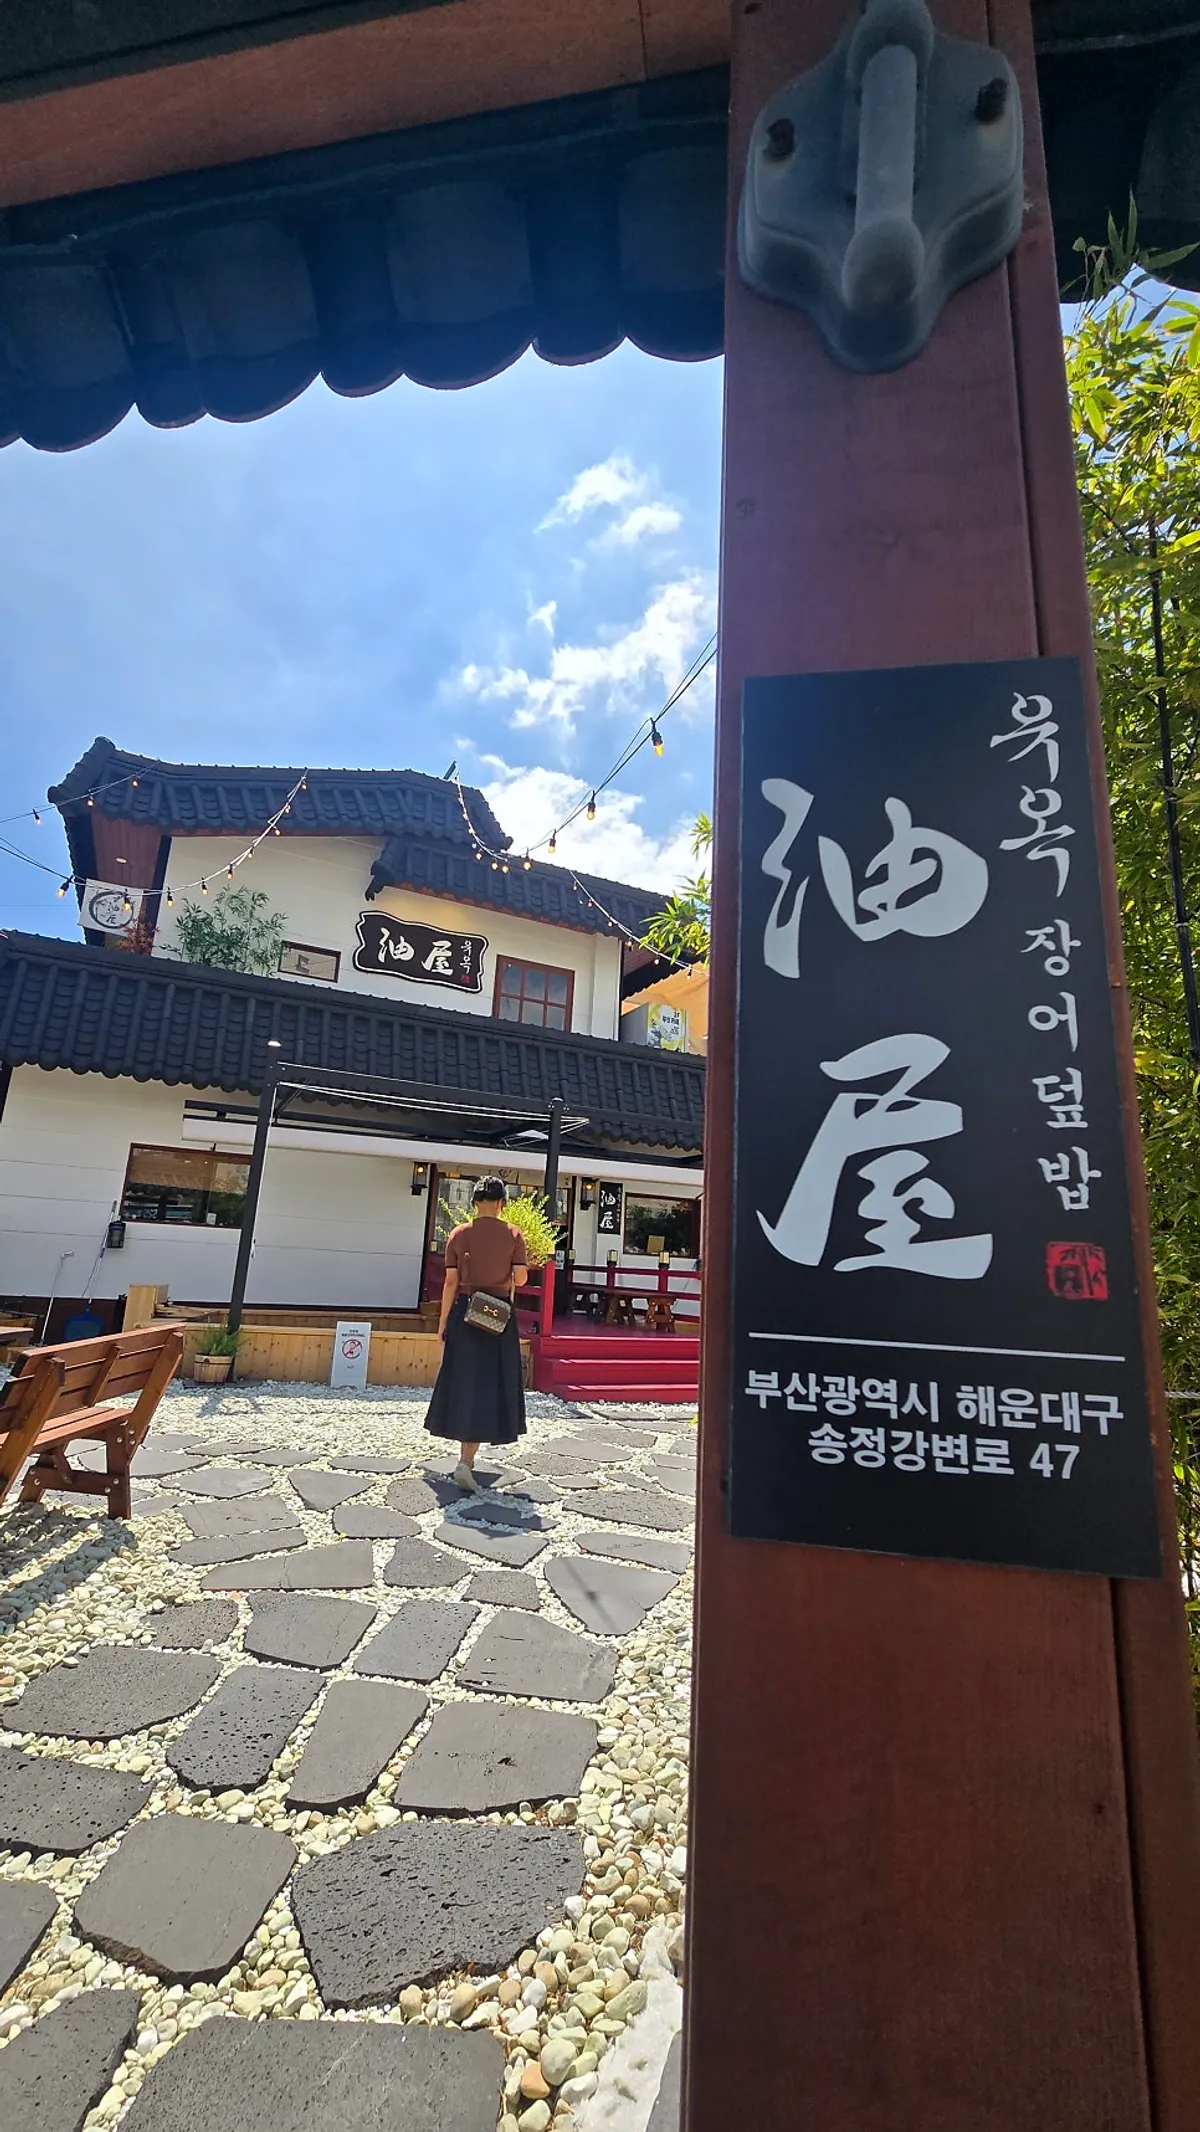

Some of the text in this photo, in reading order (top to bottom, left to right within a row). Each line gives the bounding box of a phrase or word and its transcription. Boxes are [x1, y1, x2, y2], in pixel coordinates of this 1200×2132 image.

[378, 927, 454, 976] 油屋
[756, 778, 994, 1280] 油屋
[1020, 918, 1102, 1211] 장어덮밥
[599, 1190, 616, 1229] 油屋
[745, 1369, 1124, 1435] 부산광역시 해운대구
[808, 1422, 1080, 1480] 송정강변로 47
